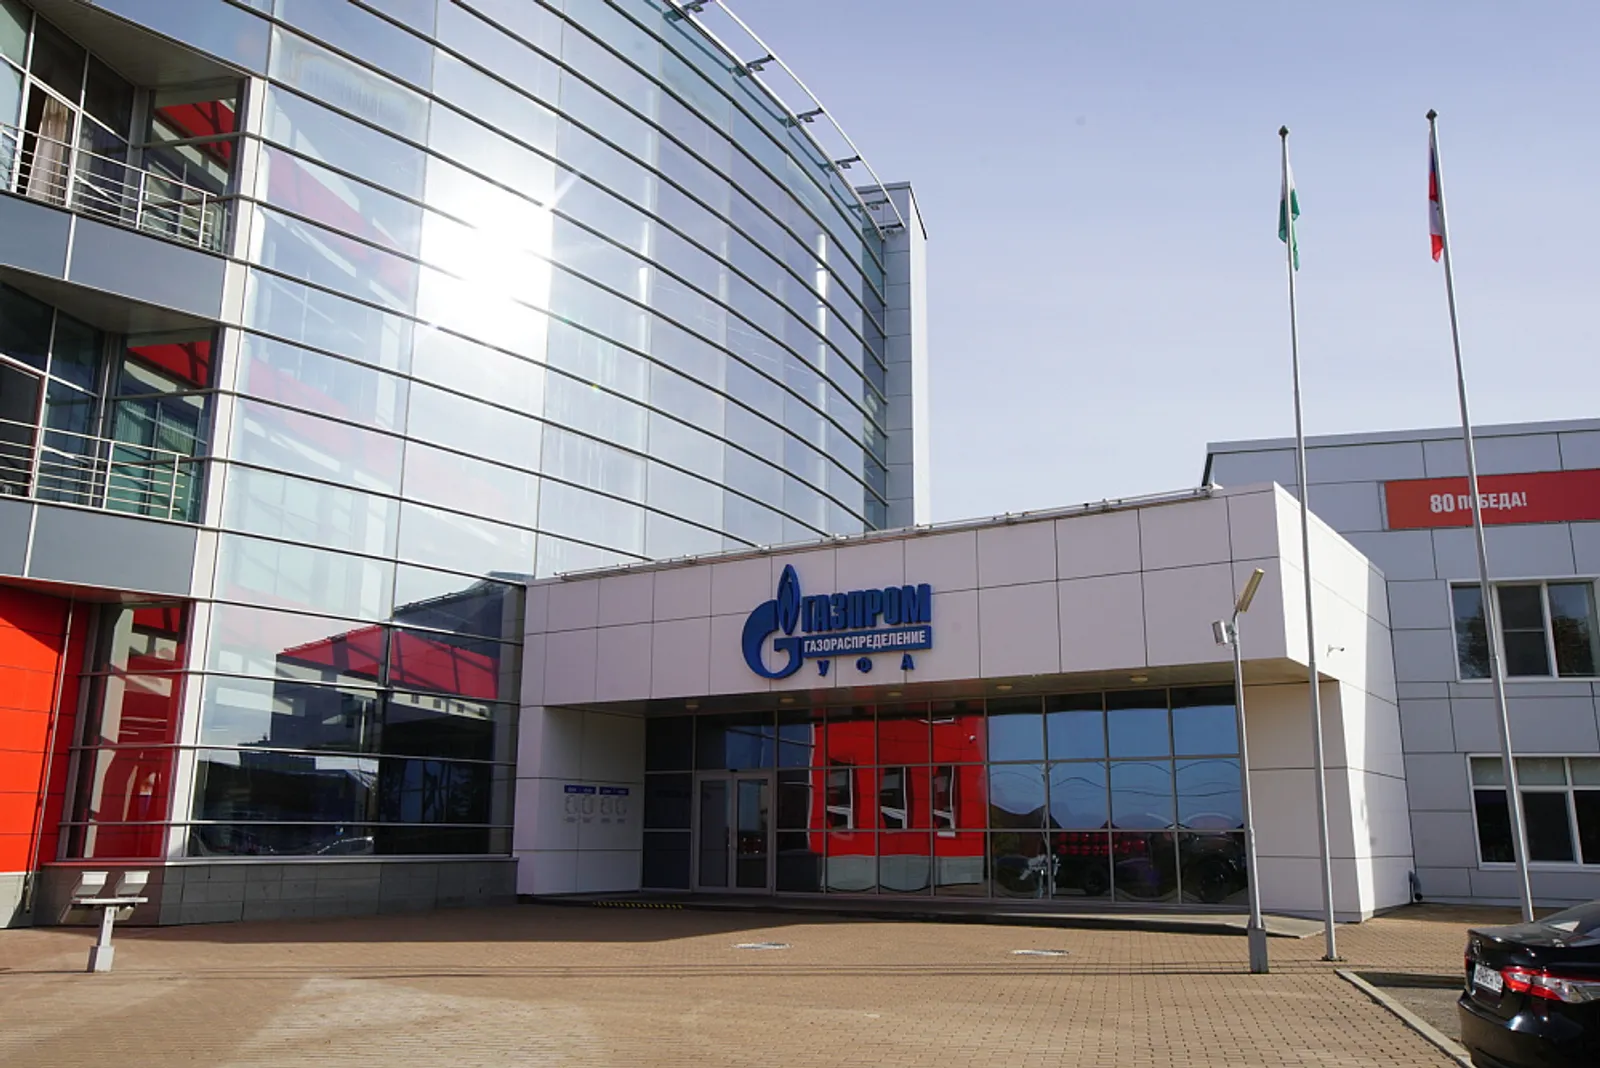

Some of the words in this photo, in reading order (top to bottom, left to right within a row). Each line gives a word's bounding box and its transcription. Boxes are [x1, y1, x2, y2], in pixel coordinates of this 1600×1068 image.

[1430, 494, 1455, 513] 80
[802, 584, 931, 632] ГАЗПРОМ
[804, 631, 926, 653] ГАЗОРАСПРЕДЕЛЕНИЕ
